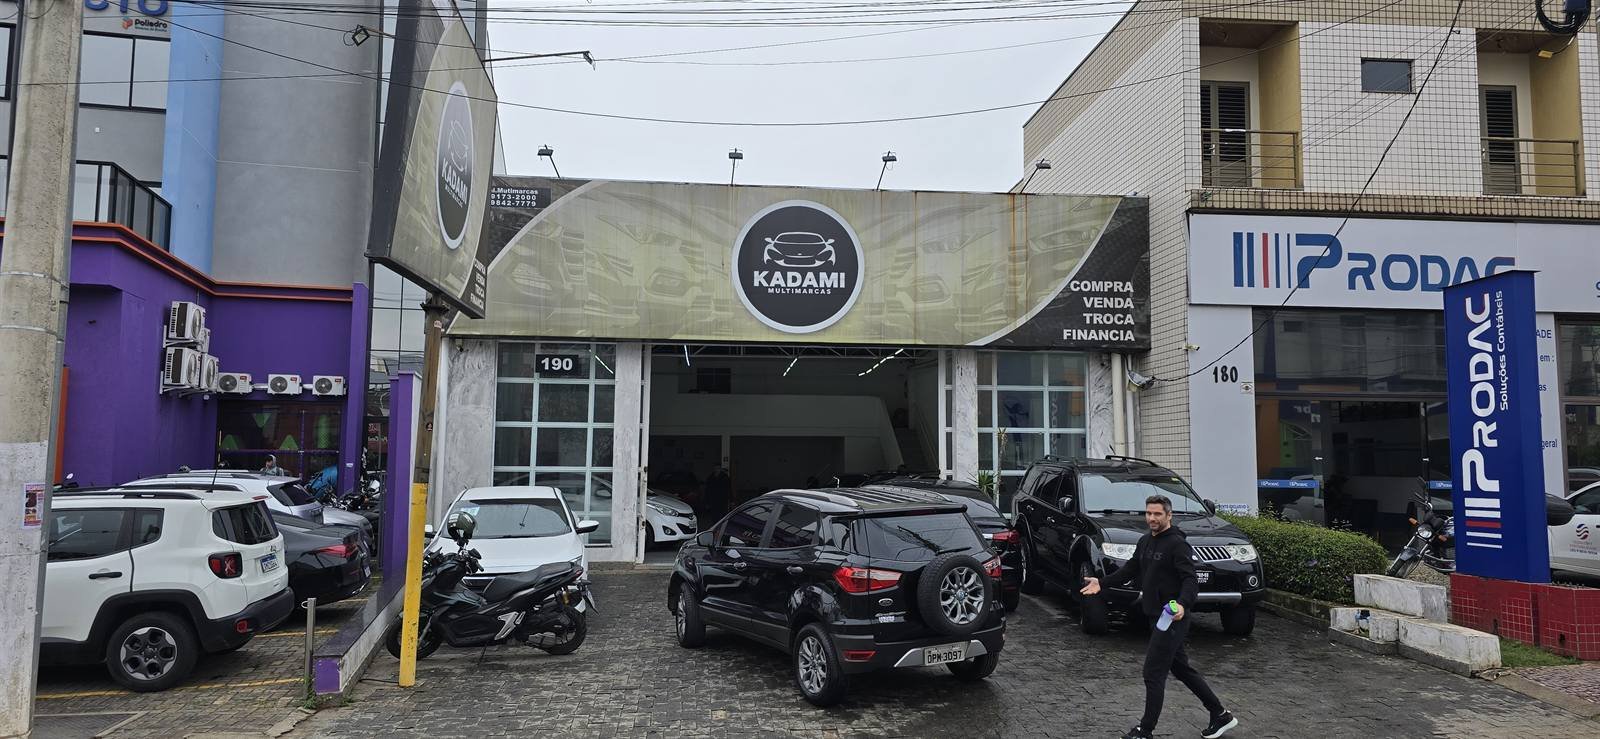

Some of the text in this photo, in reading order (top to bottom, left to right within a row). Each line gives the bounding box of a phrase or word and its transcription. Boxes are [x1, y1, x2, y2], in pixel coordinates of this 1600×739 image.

[134, 18, 168, 29] Poliedro
[441, 157, 469, 205] KADAMI
[753, 270, 846, 289] KADAMI
[767, 287, 832, 295] MULTIMARCAS
[1070, 280, 1135, 293] COMPRA
[1082, 296, 1135, 309] VENDA
[1082, 312, 1135, 325] TROCA
[1063, 328, 1136, 341] FINANCIA
[1494, 290, 1509, 411] Soluções Contábeis
[541, 357, 573, 371] 190
[1212, 365, 1239, 384] 180
[1461, 292, 1500, 492] PRODAC
